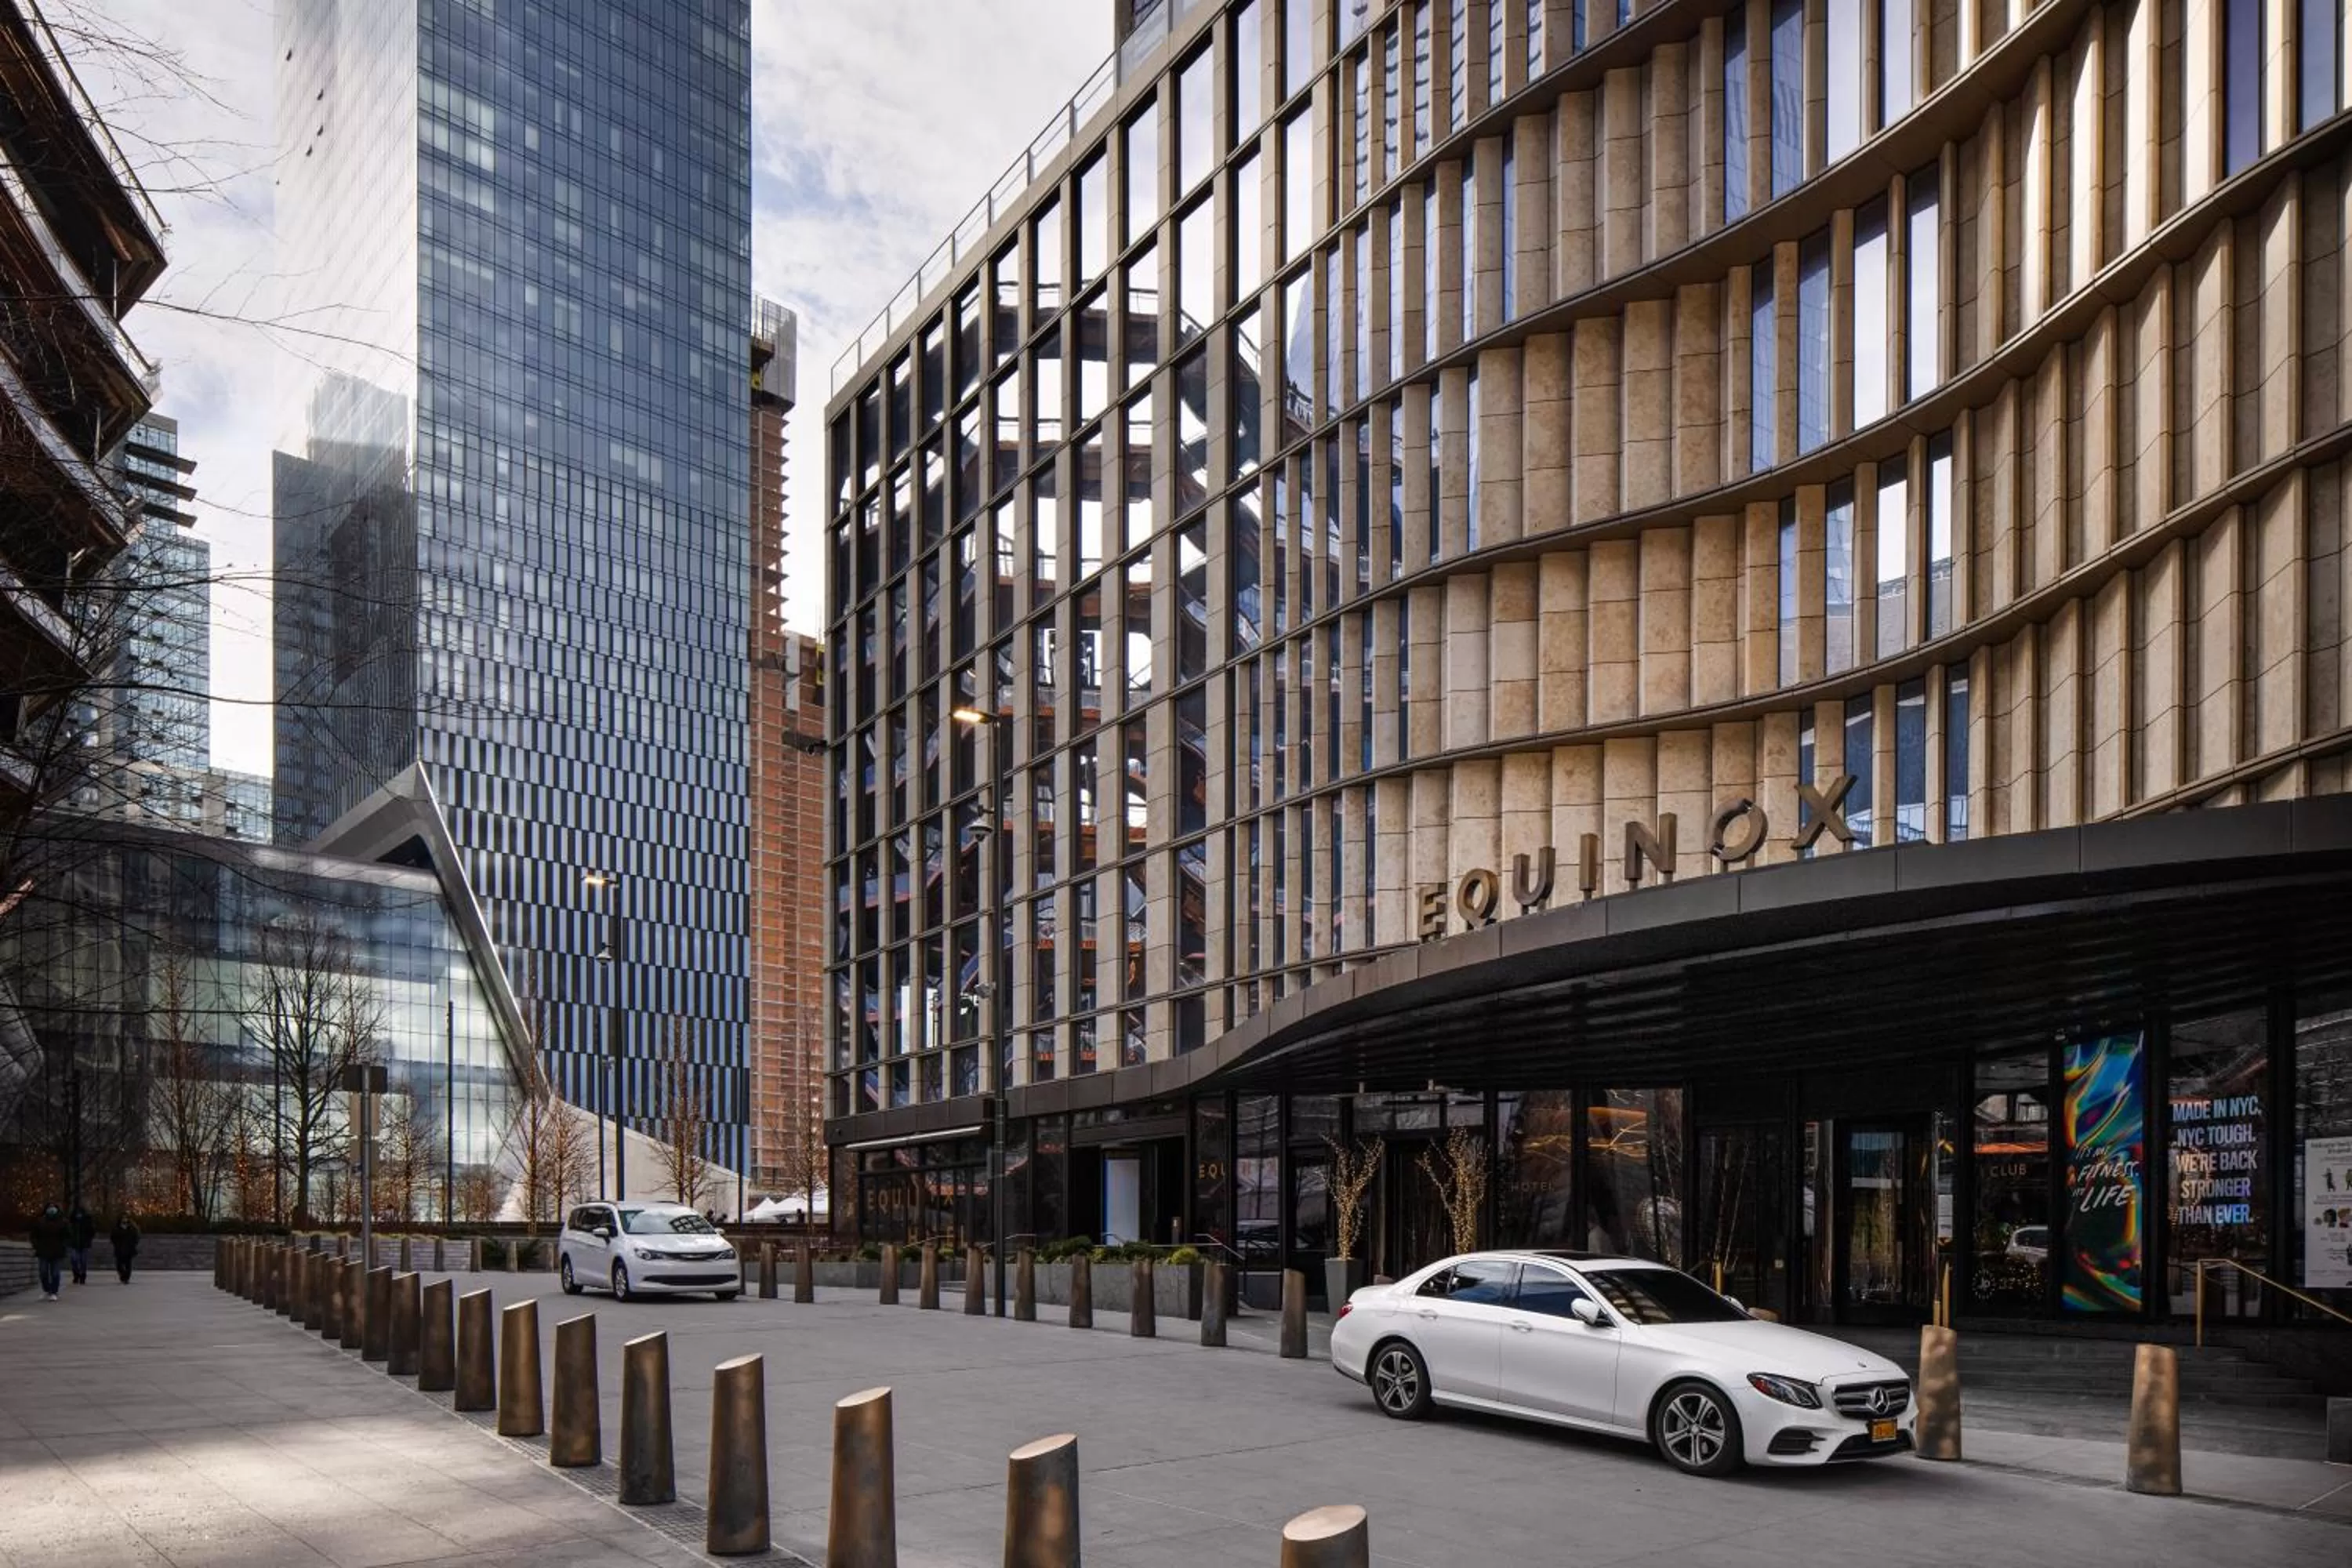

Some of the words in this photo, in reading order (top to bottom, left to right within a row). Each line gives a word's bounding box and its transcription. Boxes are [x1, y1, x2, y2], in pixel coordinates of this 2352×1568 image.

[1417, 775, 1857, 940] EQUINOX
[2172, 1100, 2212, 1123] MADE
[2213, 1098, 2227, 1119] IN
[2229, 1095, 2262, 1117] NYC.
[2177, 1127, 2205, 1147] NYC
[2207, 1123, 2256, 1145] TOUGH.
[1990, 1163, 2027, 1178] CLUB
[2176, 1152, 2218, 1173] WE'RE
[2220, 1149, 2259, 1171] BACK
[1511, 1181, 1555, 1192] HOTEL
[2180, 1177, 2252, 1199] STRONGER
[2080, 1185, 2136, 1213] LIFE.
[2179, 1203, 2212, 1225] THAN
[2215, 1203, 2255, 1224] EVER.
